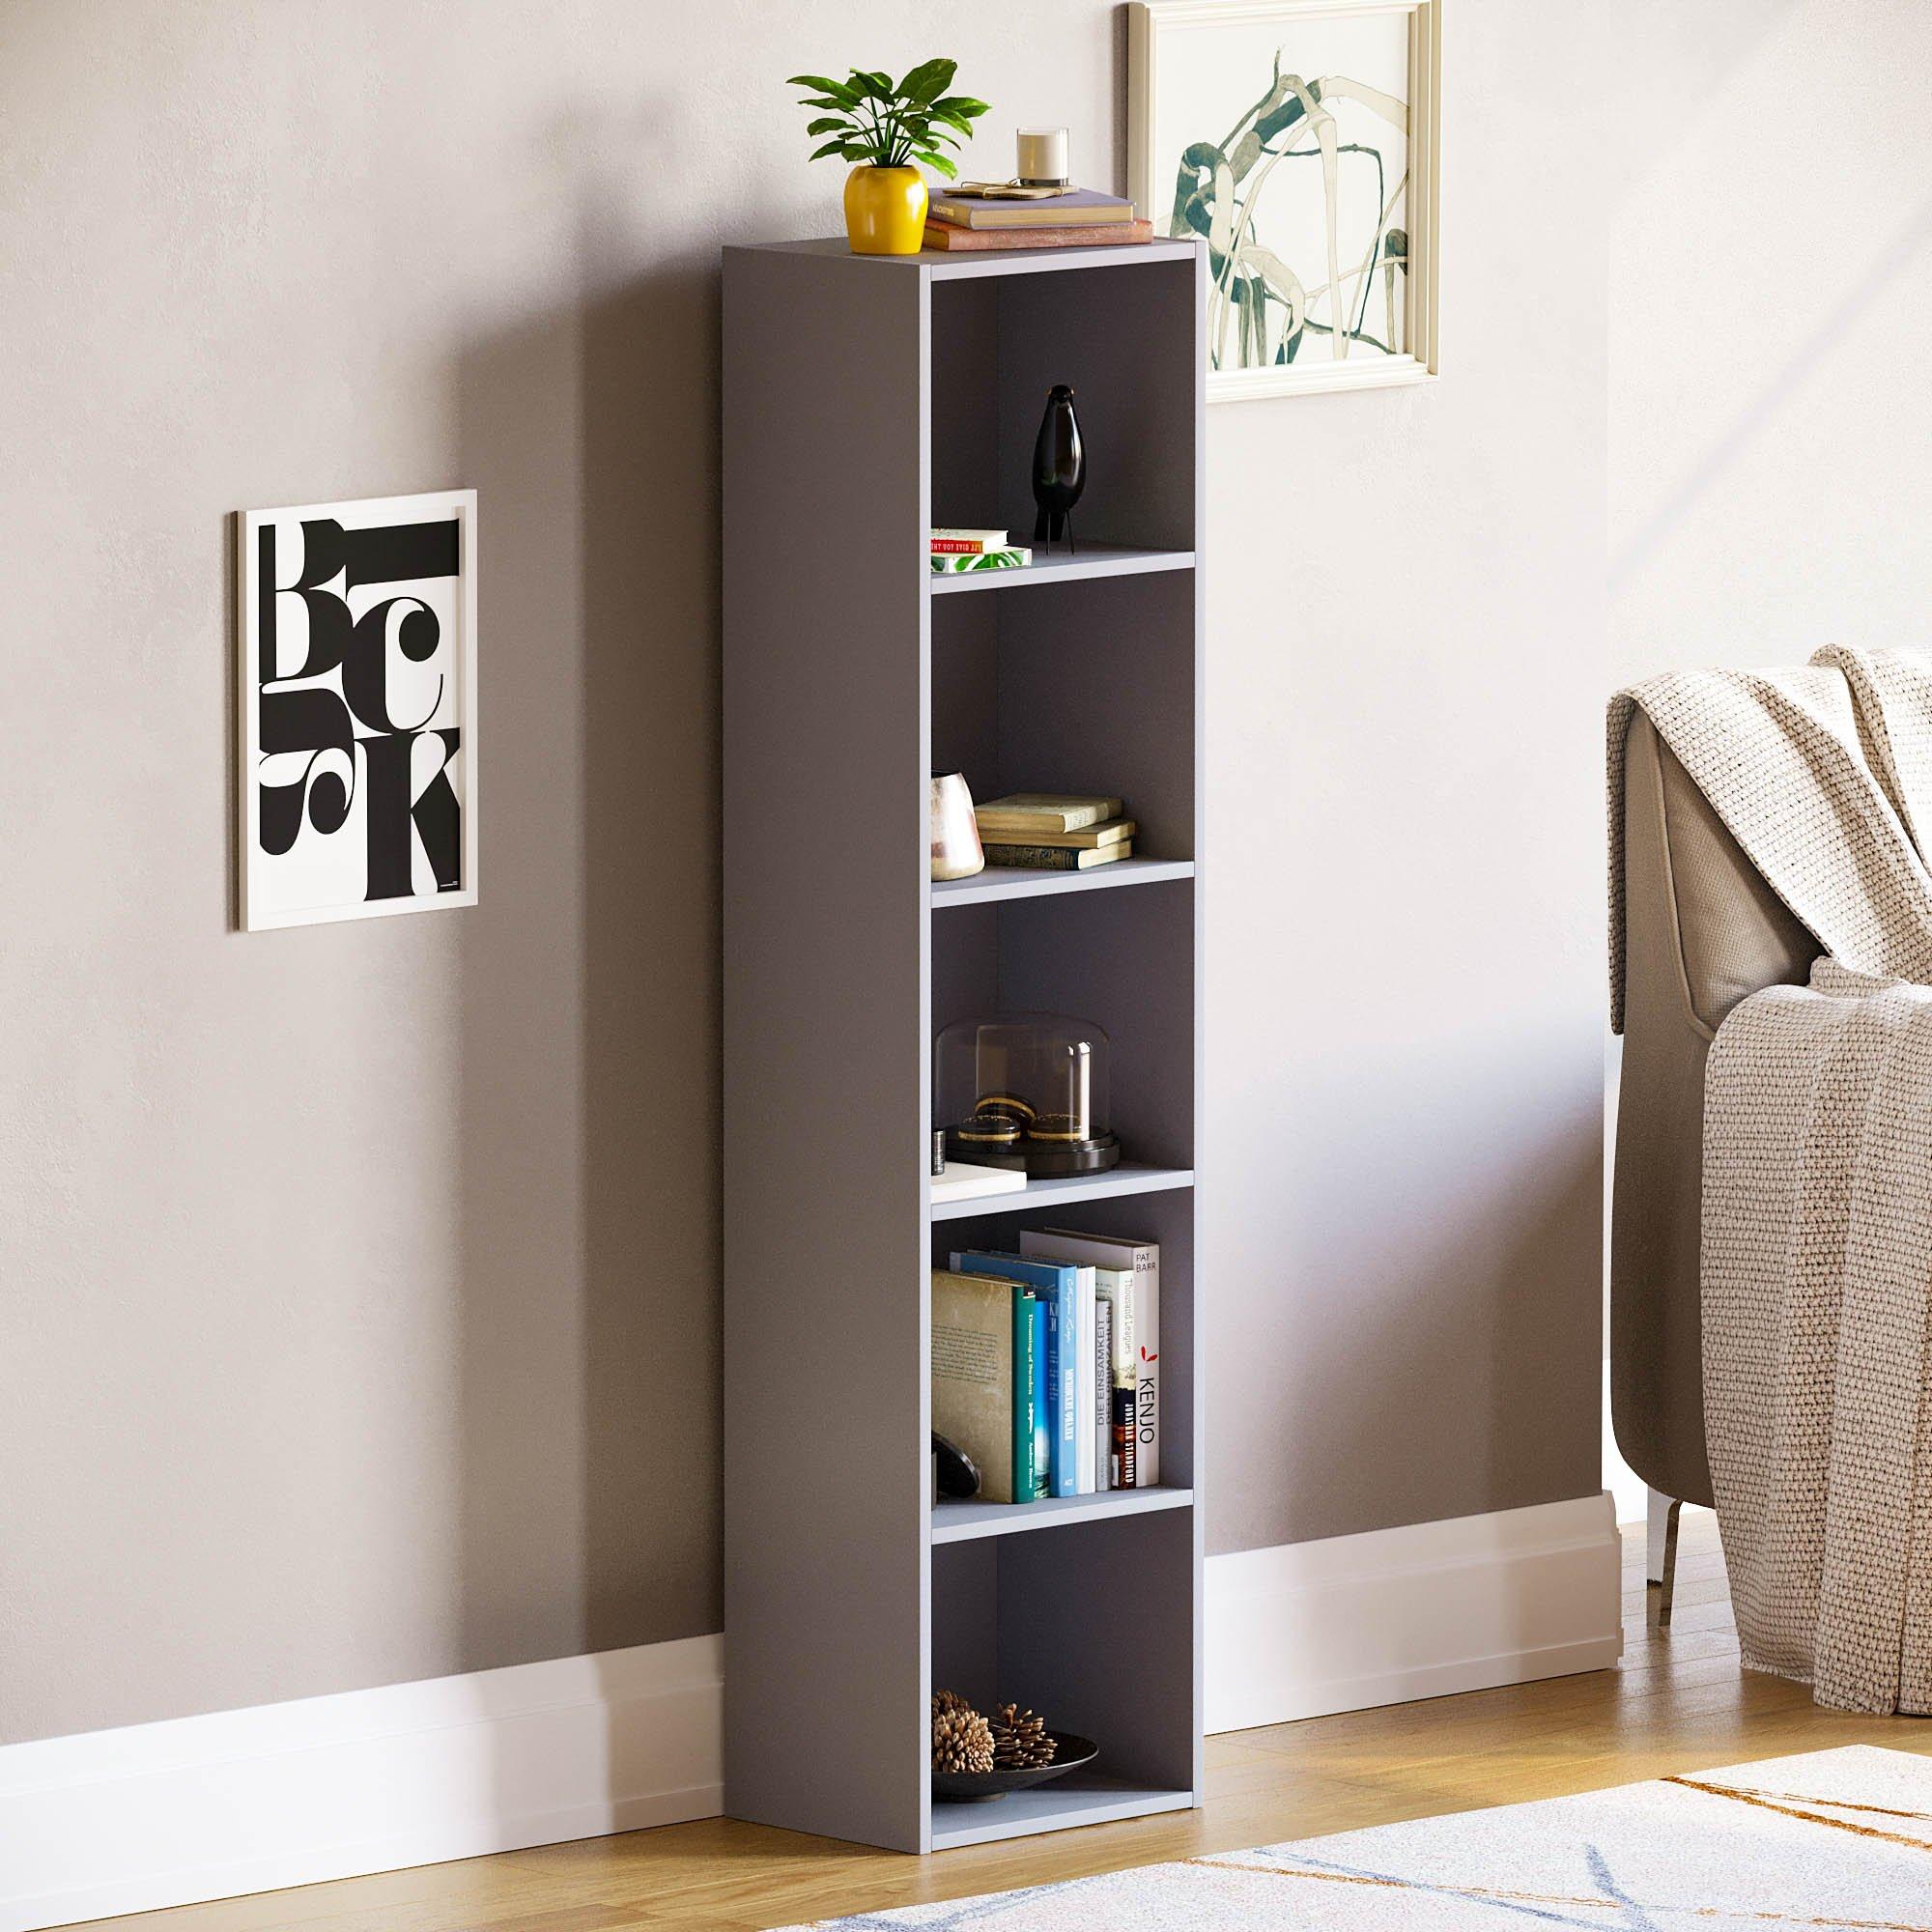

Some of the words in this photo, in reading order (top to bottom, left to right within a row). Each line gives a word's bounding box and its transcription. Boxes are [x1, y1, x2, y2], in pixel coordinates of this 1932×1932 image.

[1136, 1252, 1151, 1262] PAT
[1136, 1262, 1155, 1273] BARR
[1096, 1321, 1105, 1400] EINSAMKEIT
[1096, 1403, 1105, 1426] DIE
[1124, 1403, 1134, 1440] JONATHAN
[1139, 1377, 1155, 1444] KENJO
